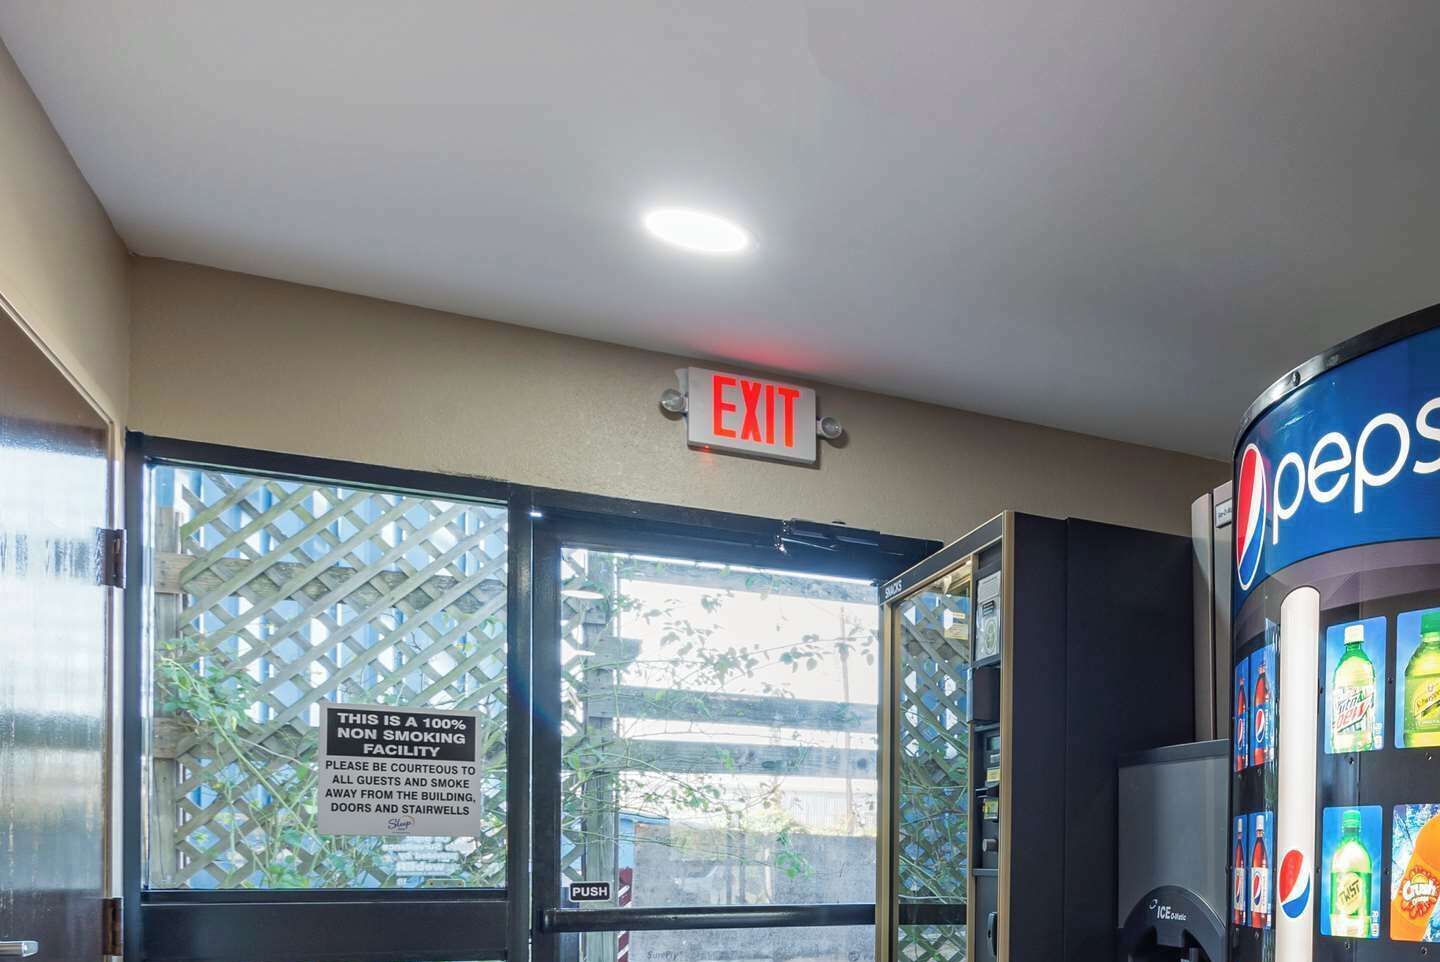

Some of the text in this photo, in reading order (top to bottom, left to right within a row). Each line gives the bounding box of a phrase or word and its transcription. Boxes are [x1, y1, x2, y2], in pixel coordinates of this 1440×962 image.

[713, 374, 800, 448] EXIT
[884, 580, 902, 599] SNACKS
[337, 712, 467, 730] THIS IS A 100%
[337, 727, 466, 744] NON SMOKING
[363, 743, 441, 757] FACILITY
[325, 760, 476, 776] PLEASE BE COURTEOUS TO
[332, 775, 470, 789] ALL GUESTS AND SMOKE
[325, 789, 476, 803] AWAY FROM THE BUILDING,
[331, 802, 470, 816] DOORS AND STAIRWELLS
[572, 886, 608, 897] PUSH
[1157, 905, 1171, 920] ICE
